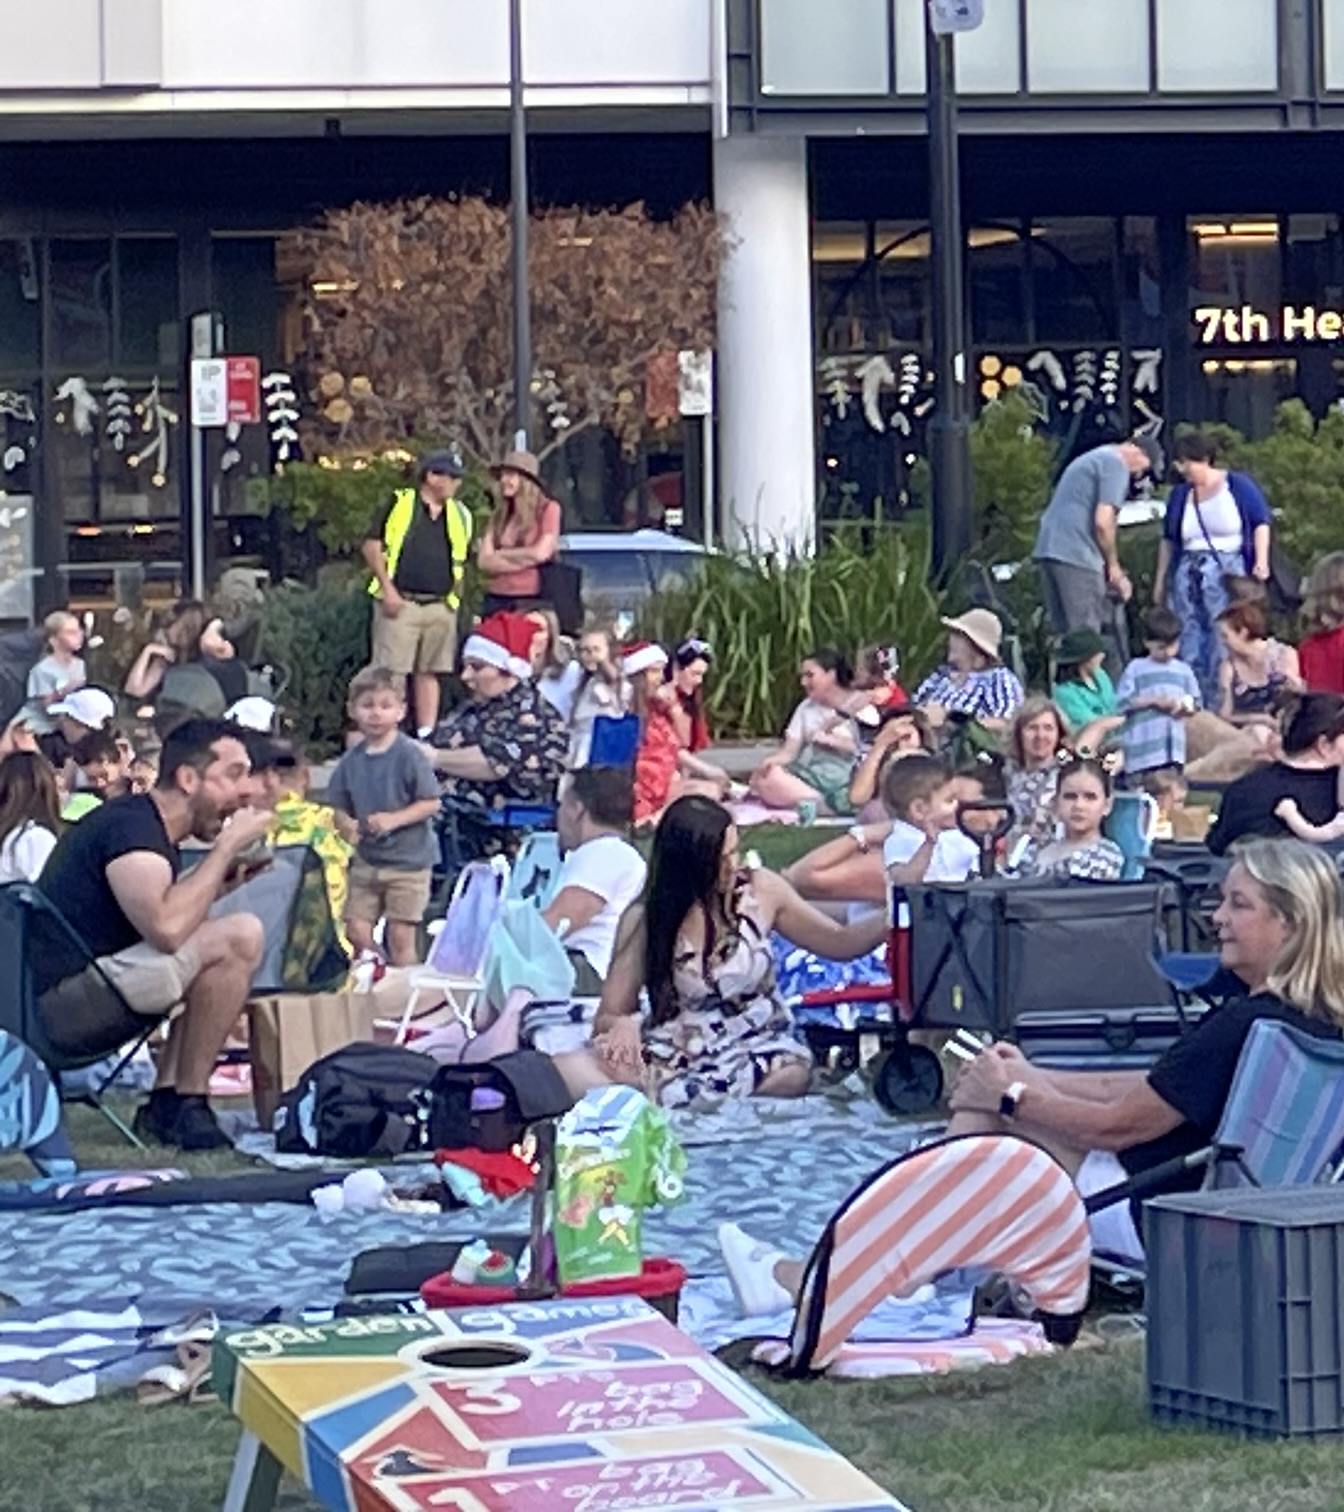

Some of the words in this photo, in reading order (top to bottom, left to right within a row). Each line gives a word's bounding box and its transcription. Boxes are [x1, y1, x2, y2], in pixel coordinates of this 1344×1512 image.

[1194, 306, 1269, 343] 7th
[225, 1317, 434, 1357] garden
[444, 1377, 522, 1415] 3
